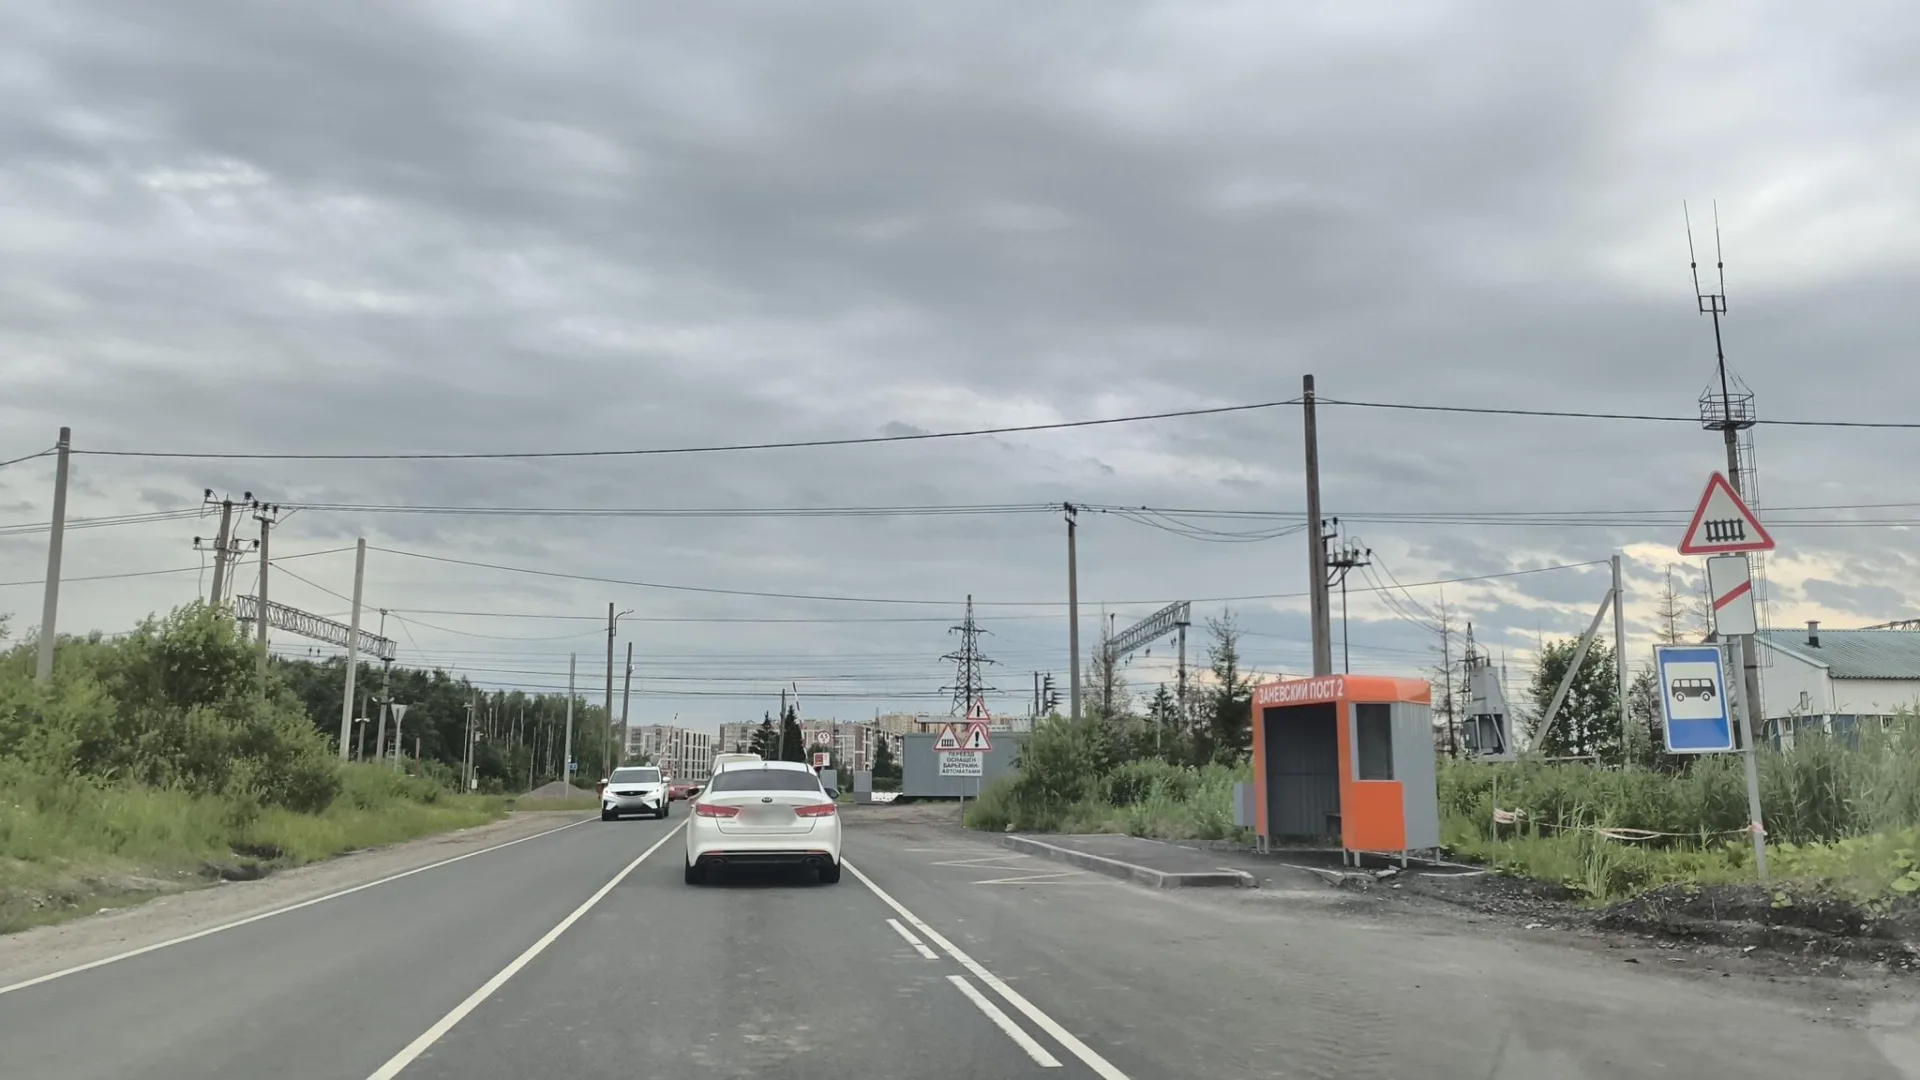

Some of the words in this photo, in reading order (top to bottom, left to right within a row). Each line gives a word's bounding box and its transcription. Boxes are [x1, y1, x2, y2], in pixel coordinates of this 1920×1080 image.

[1259, 681, 1307, 704] ЗАНЕВСКИЙ
[1310, 680, 1336, 698] ПОСТ
[1337, 678, 1344, 697] 2
